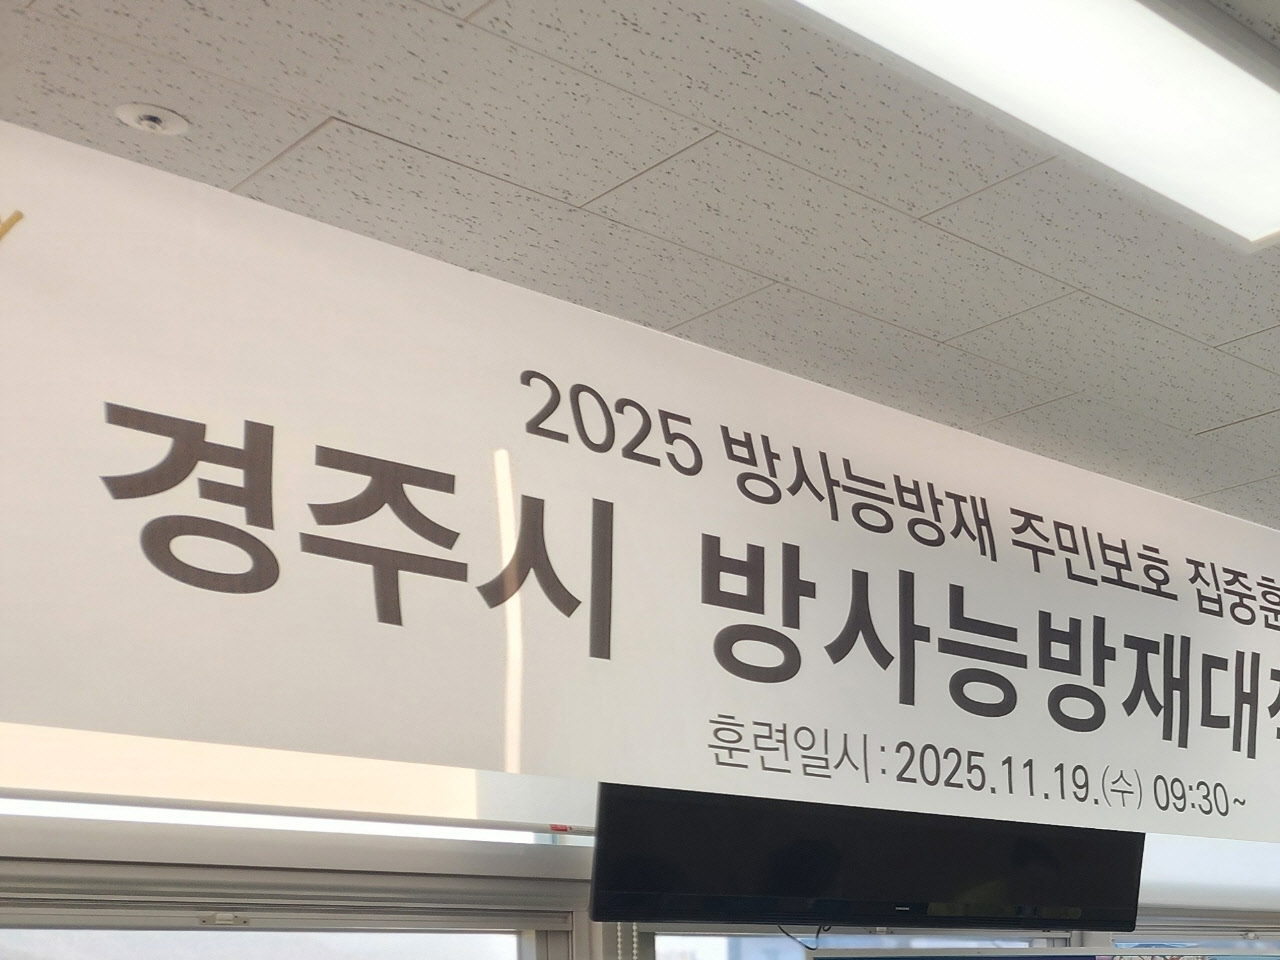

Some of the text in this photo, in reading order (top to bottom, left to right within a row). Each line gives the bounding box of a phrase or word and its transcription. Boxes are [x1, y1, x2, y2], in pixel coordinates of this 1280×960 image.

[99, 400, 614, 661] 경주시
[520, 369, 704, 477] 2025
[719, 424, 998, 563] 방사능방재
[1008, 506, 1179, 602] 주민보호
